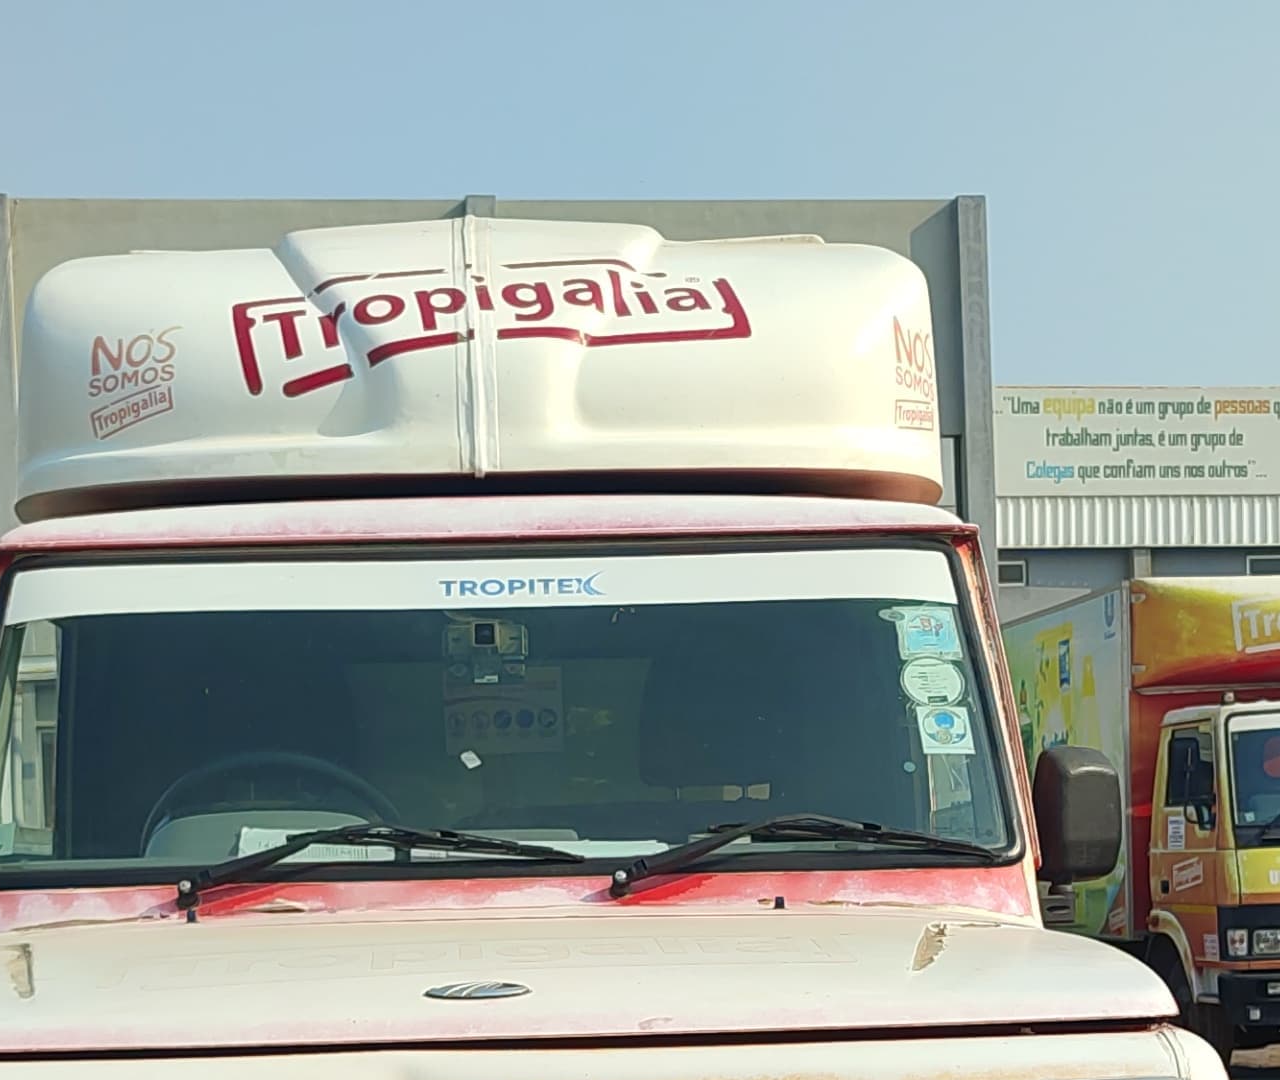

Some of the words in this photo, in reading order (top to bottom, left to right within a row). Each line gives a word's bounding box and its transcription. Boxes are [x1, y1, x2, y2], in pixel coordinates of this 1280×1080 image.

[263, 270, 711, 361] Tropigalia
[87, 364, 176, 397] SOMOS
[895, 365, 934, 401] SOMOS
[95, 390, 167, 432] Tropigalia
[1043, 396, 1096, 421] equipa
[1098, 398, 1123, 414] não
[1125, 398, 1134, 414] é
[1136, 401, 1155, 414] um
[1158, 401, 1194, 420] grupo
[1196, 395, 1212, 414] de
[1214, 399, 1271, 421] pessoas
[1046, 427, 1112, 447] trabalham
[1158, 430, 1166, 447] é
[1168, 433, 1188, 446] um
[1190, 433, 1226, 451] grupo
[1228, 427, 1244, 446] de
[1026, 459, 1075, 484] Colegas
[1077, 464, 1100, 484] que
[1103, 458, 1156, 478] confiam
[1159, 464, 1181, 478] uns
[1183, 464, 1206, 478] nos
[438, 570, 608, 597] TROPITEX
